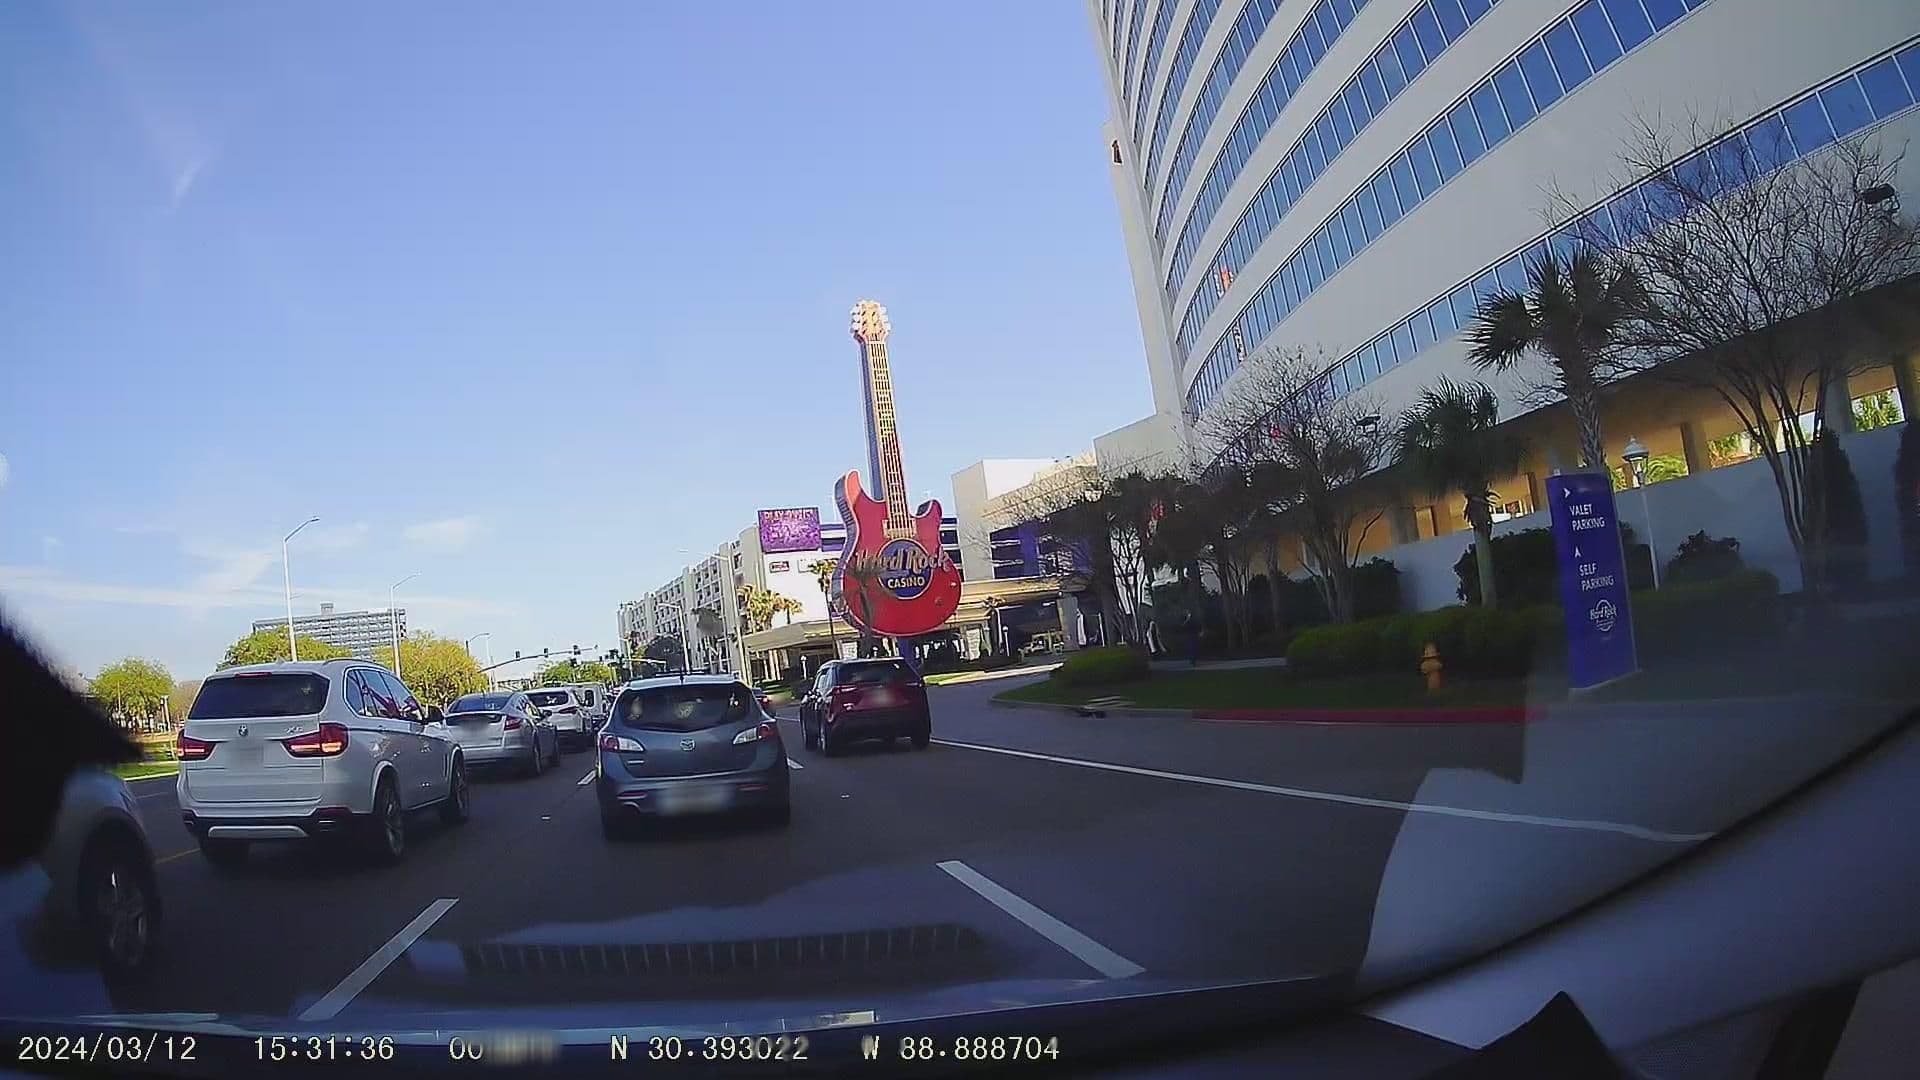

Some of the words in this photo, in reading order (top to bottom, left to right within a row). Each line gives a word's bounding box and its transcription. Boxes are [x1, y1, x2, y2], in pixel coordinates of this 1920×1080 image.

[1569, 503, 1592, 516] VALET
[1572, 516, 1605, 531] PARKING
[905, 544, 950, 574] Rock
[1579, 562, 1597, 576] SELF
[887, 577, 925, 588] CASINO
[1581, 575, 1614, 592] PARKING
